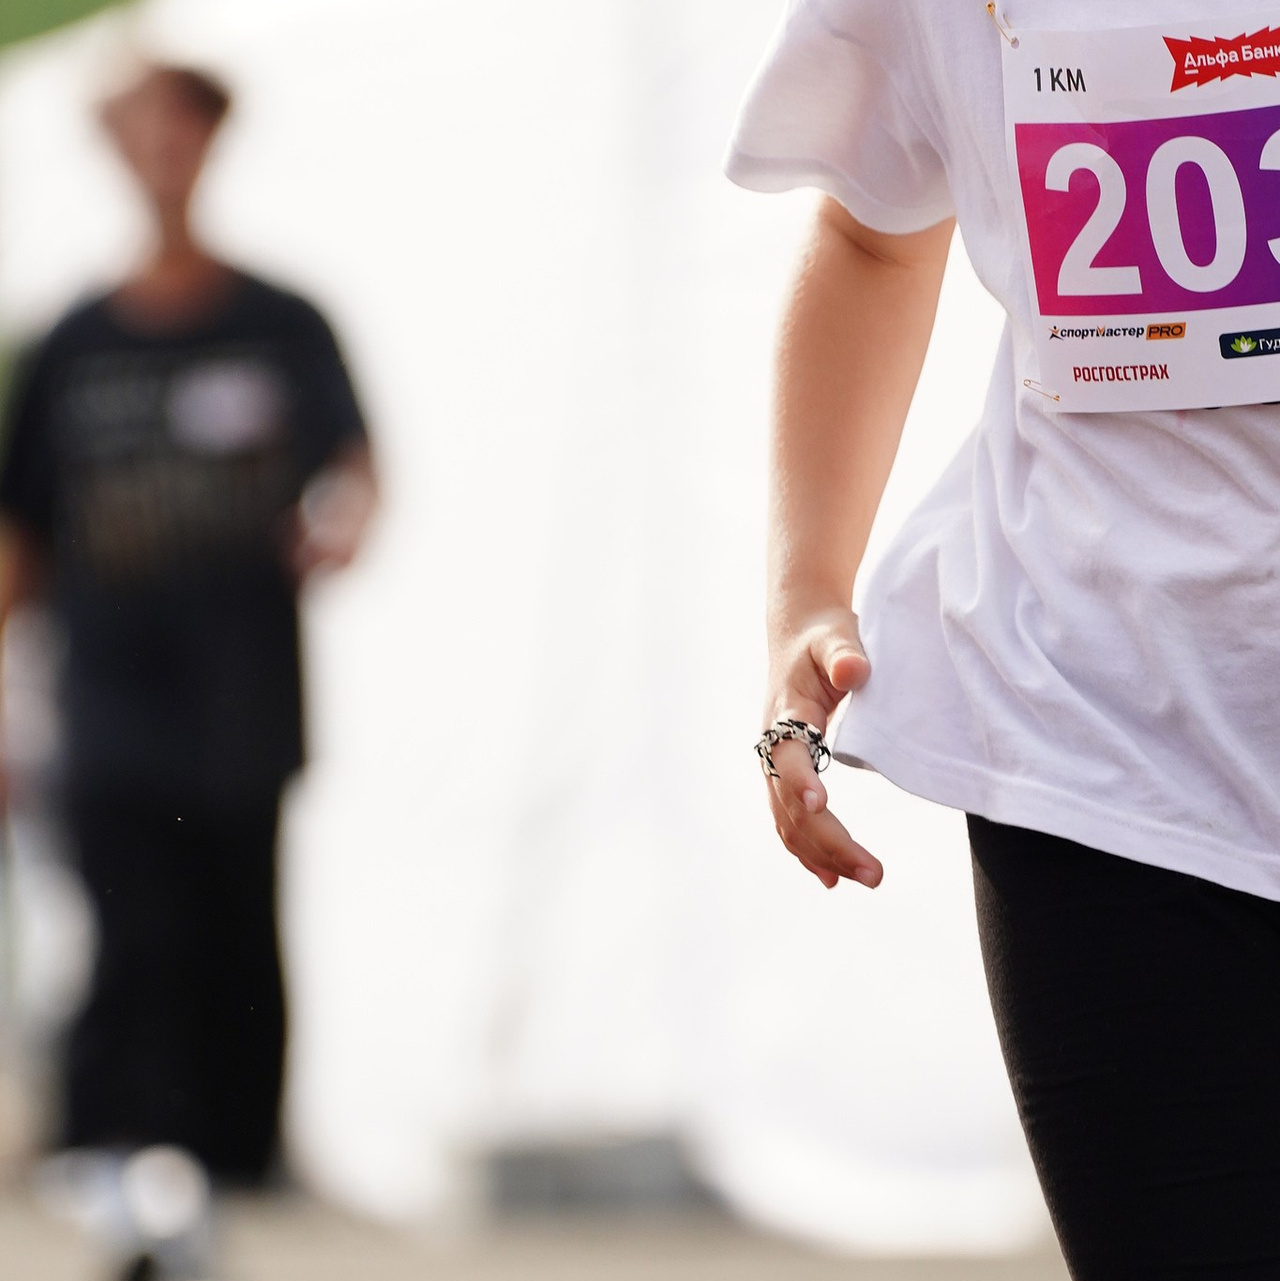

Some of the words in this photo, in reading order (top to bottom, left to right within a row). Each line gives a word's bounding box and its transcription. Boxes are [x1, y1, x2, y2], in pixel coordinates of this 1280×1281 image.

[1184, 48, 1238, 74] Альфа
[1034, 67, 1042, 92] 1
[1148, 325, 1183, 338] PRO
[1073, 364, 1170, 382] РОСГОССТРАХ
